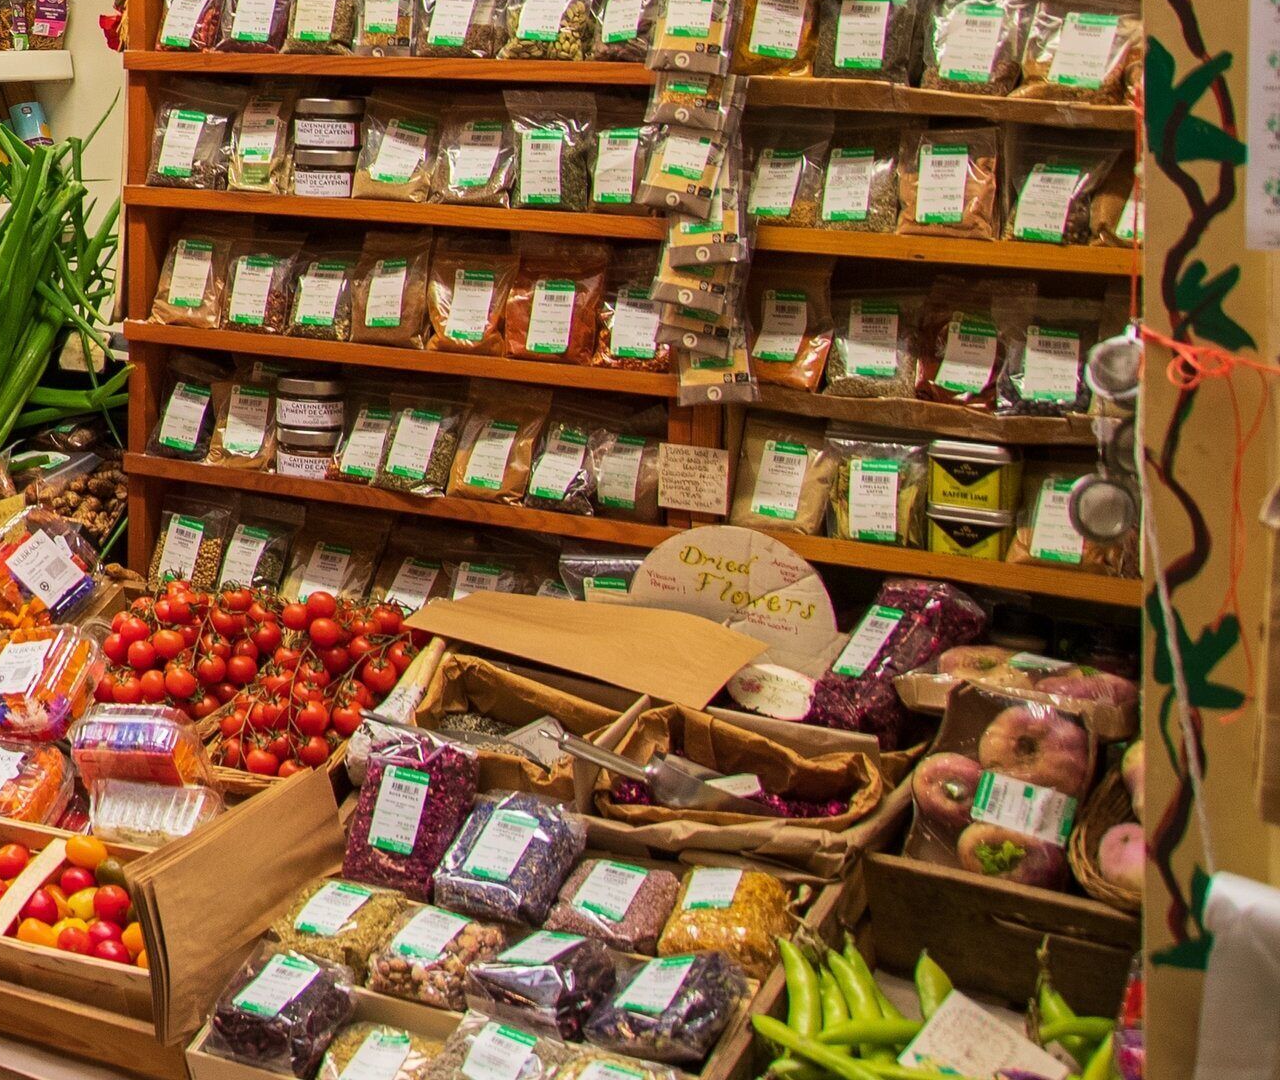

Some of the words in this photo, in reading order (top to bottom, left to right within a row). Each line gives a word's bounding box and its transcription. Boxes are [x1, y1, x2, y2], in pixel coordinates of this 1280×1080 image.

[290, 402, 339, 411] CAYENNEPEPER
[970, 493, 989, 503] LIME
[679, 544, 759, 576] Dried
[696, 570, 816, 620] Flowers
